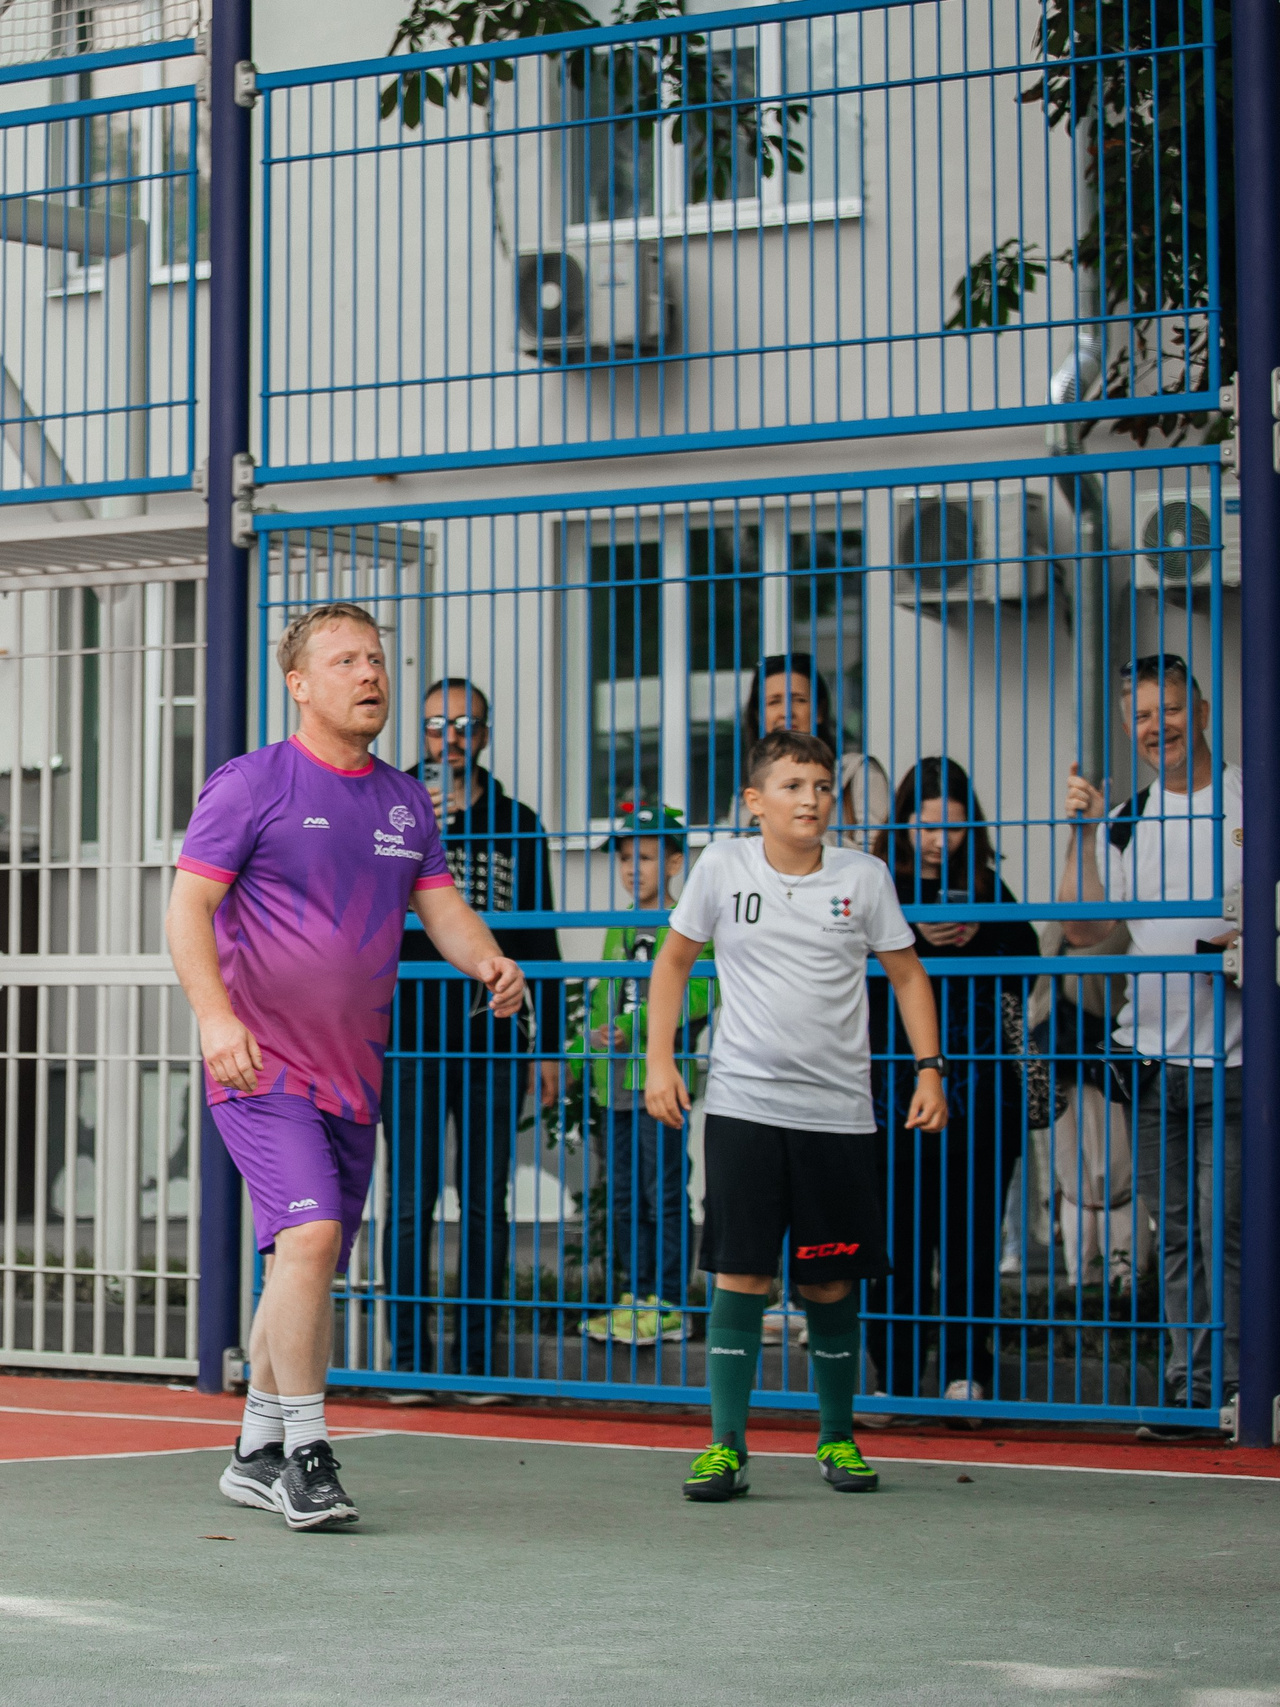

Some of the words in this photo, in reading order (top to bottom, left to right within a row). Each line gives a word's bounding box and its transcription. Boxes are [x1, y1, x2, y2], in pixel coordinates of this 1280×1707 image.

[373, 829, 405, 845] Фонд
[732, 891, 761, 924] 10
[795, 1242, 860, 1260] CCM
